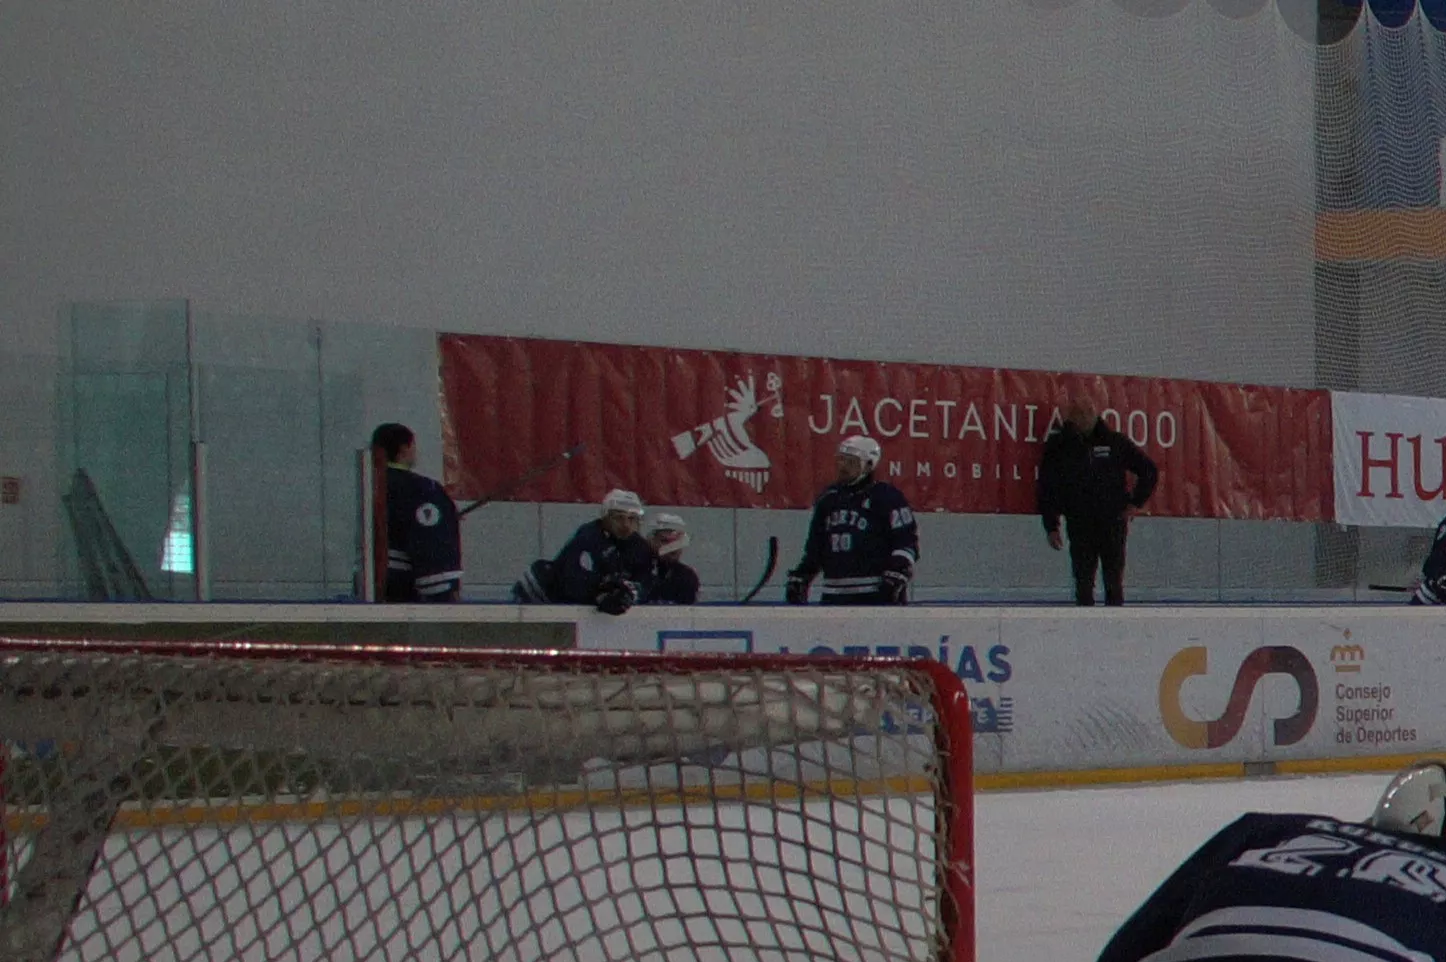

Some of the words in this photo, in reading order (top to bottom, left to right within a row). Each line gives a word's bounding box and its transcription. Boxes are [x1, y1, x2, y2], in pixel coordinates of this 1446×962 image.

[808, 393, 1064, 443] JACETANIA
[1101, 407, 1177, 449] 000
[1335, 682, 1392, 703] Consejo
[1336, 704, 1395, 725] Superior
[1336, 728, 1353, 744] de
[1356, 725, 1418, 747] Deportes
